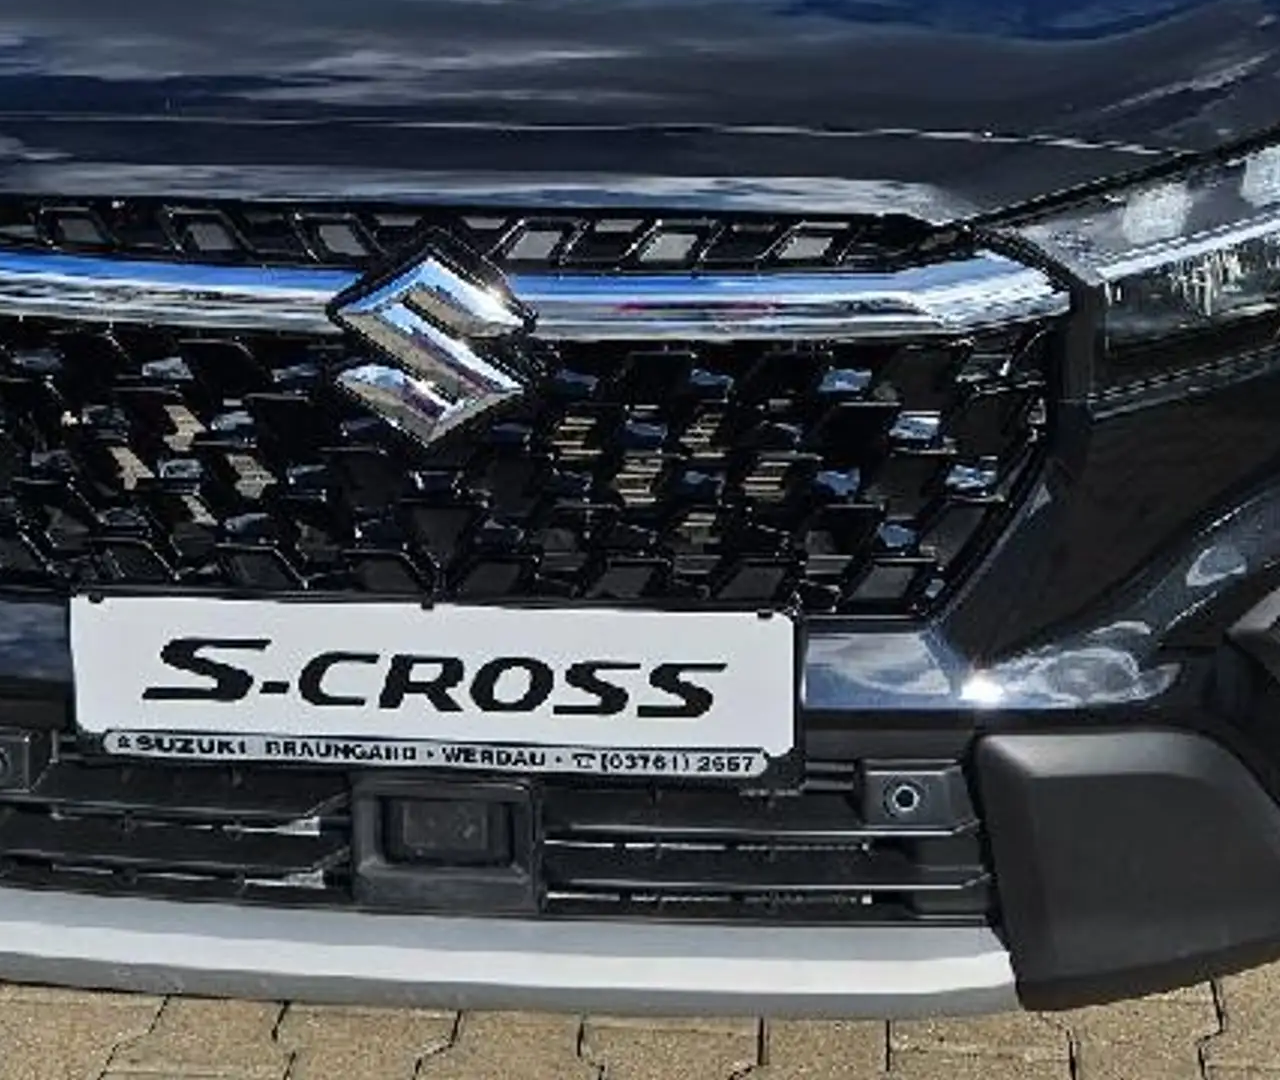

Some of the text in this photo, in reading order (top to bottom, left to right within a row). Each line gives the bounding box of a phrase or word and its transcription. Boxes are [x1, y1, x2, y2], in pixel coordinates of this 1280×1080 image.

[142, 637, 728, 718] S-CROSS
[136, 735, 247, 755] SUZUKI
[441, 747, 546, 766] WERDAU
